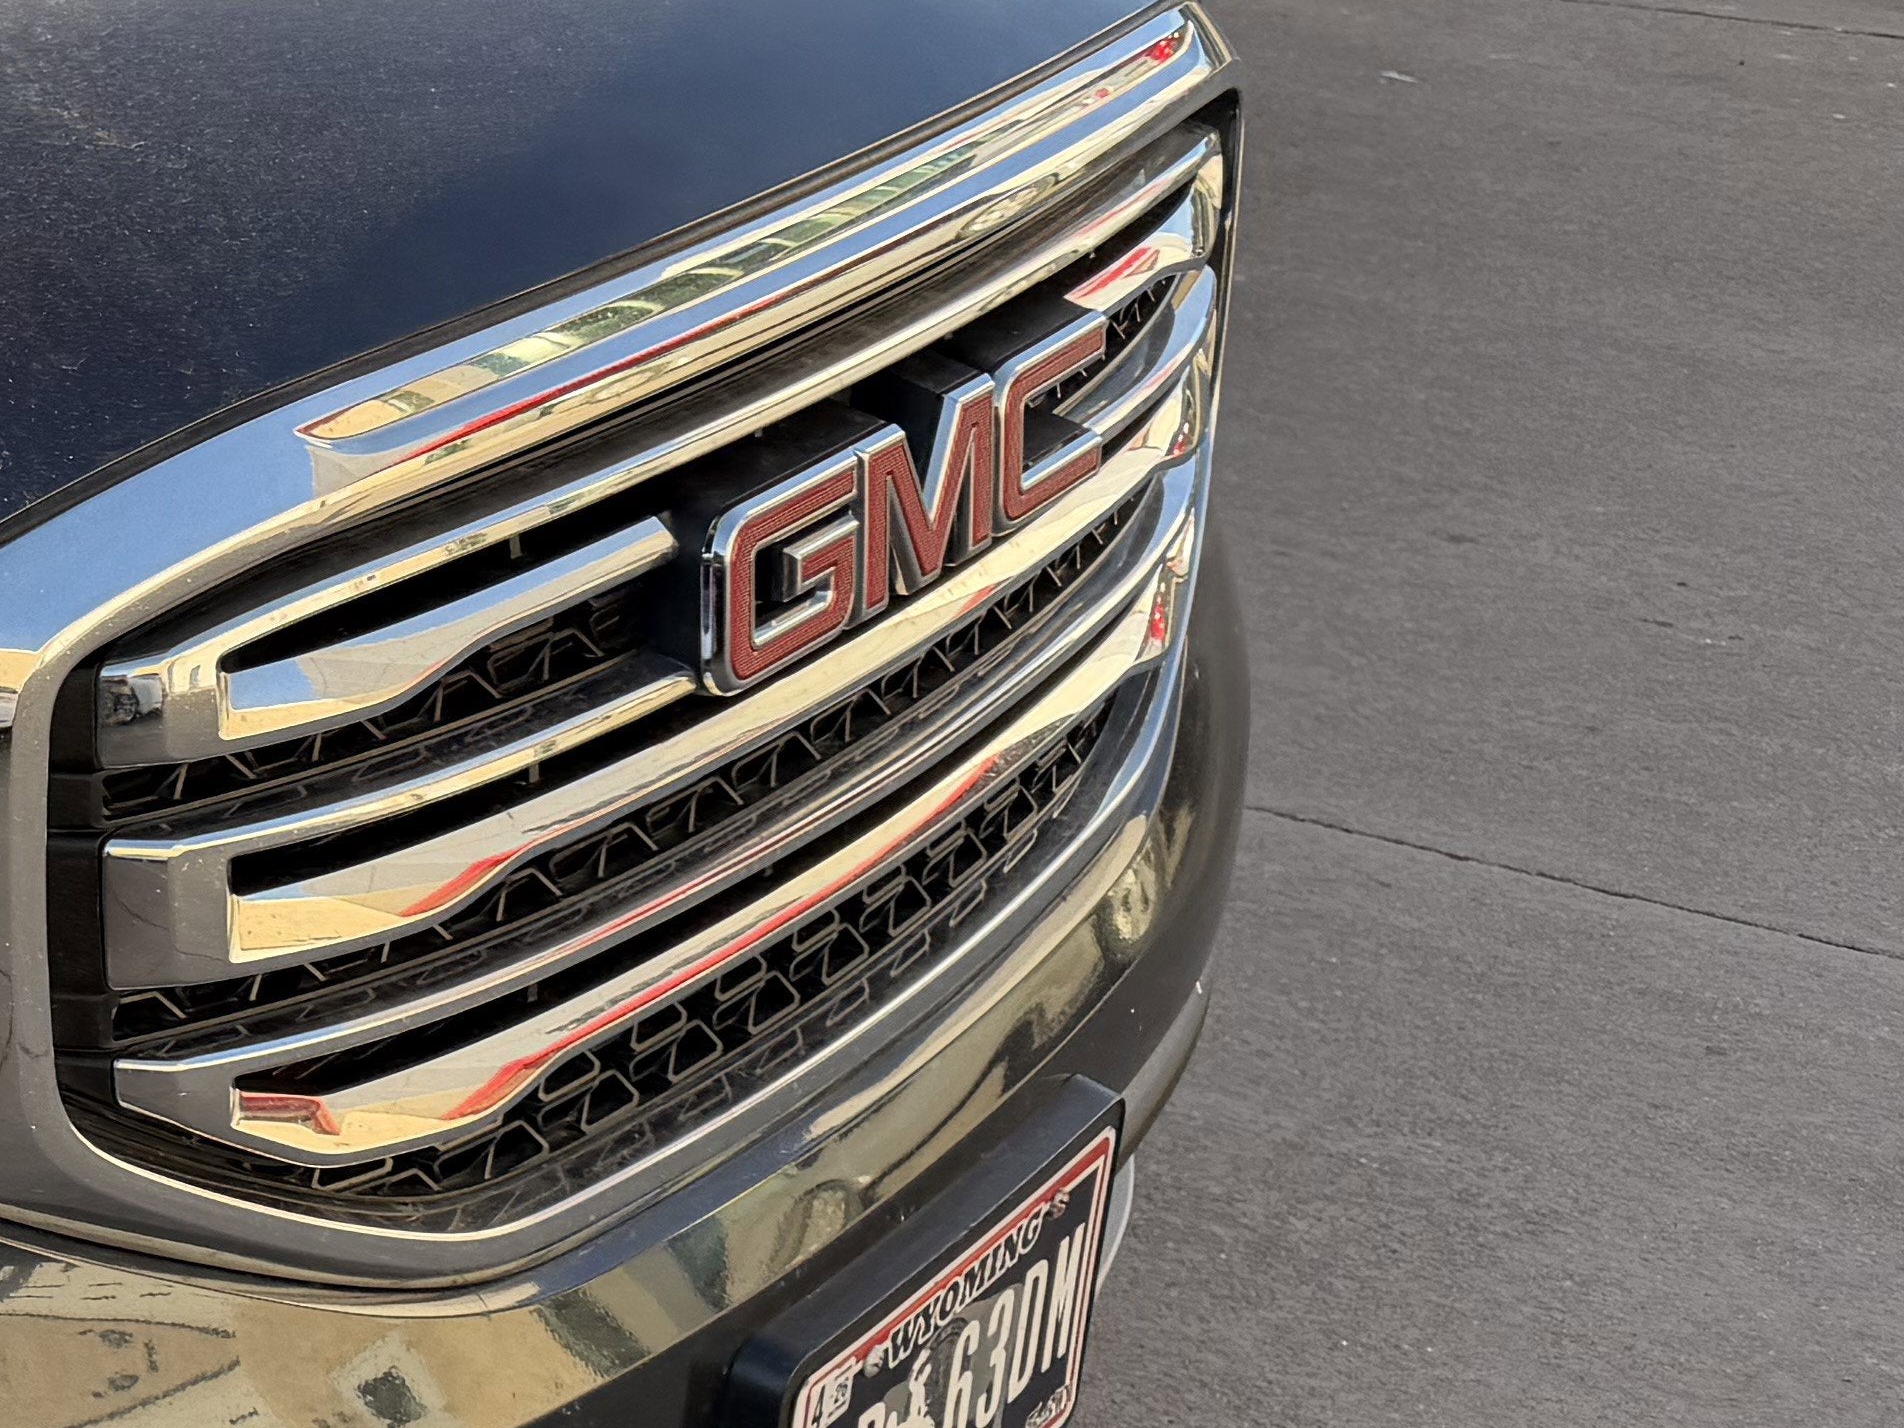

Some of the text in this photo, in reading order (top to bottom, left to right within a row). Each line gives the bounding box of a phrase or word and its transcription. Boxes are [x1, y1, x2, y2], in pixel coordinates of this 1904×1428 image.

[701, 310, 1108, 697] GMC
[887, 1208, 1044, 1369] WYOMING
[811, 1384, 826, 1428] 4
